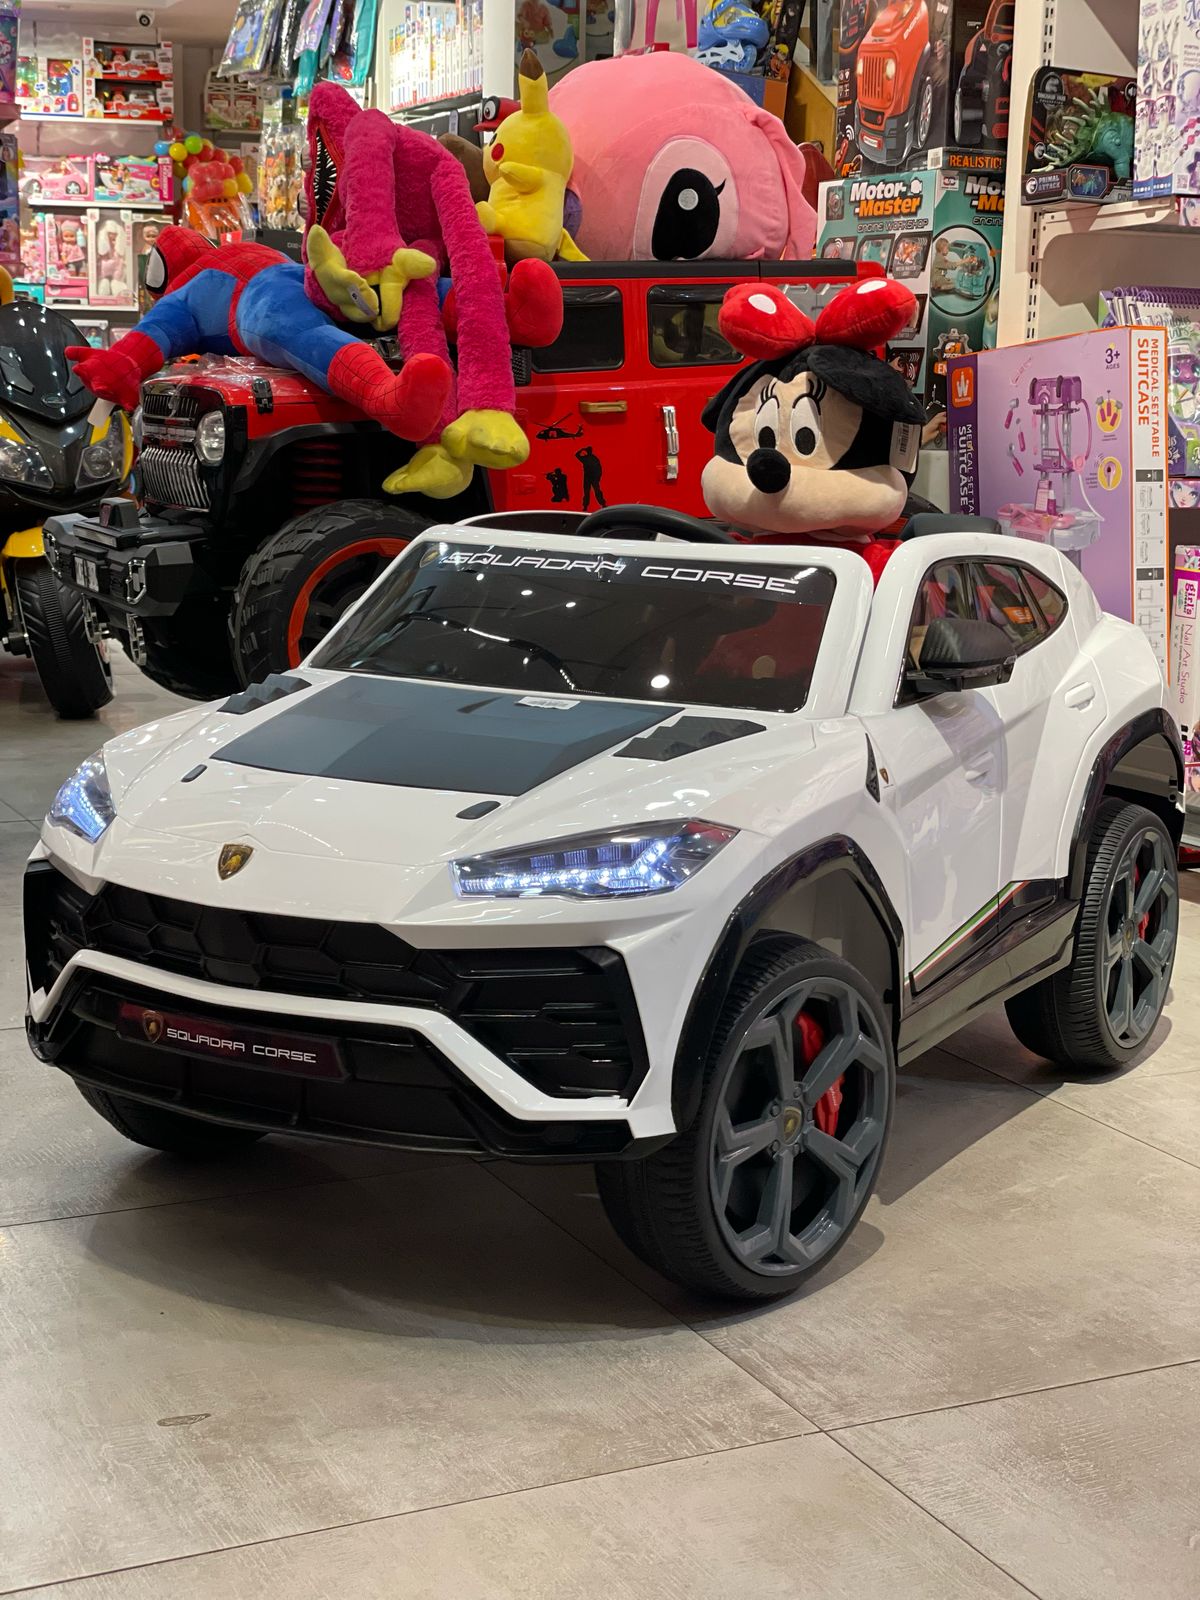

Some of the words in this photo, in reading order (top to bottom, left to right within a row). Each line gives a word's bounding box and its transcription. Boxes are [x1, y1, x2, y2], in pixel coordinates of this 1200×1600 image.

[950, 154, 1002, 169] REALISTIC!
[885, 218, 929, 231] WORKSHOP
[1105, 348, 1120, 364] 3+
[1151, 338, 1159, 392] MEDICAL
[1138, 338, 1150, 426] SUITCASE
[1151, 396, 1159, 417] SET
[1152, 422, 1160, 457] TABLE
[958, 425, 968, 506] SUITCASE
[444, 552, 627, 576] SQUADRA
[640, 566, 800, 594] CORSE
[1184, 624, 1193, 646] Nail
[1182, 649, 1191, 667] Art
[1179, 671, 1190, 703] Studio
[166, 1028, 246, 1052] SQUADRA
[252, 1045, 317, 1063] CORSE
